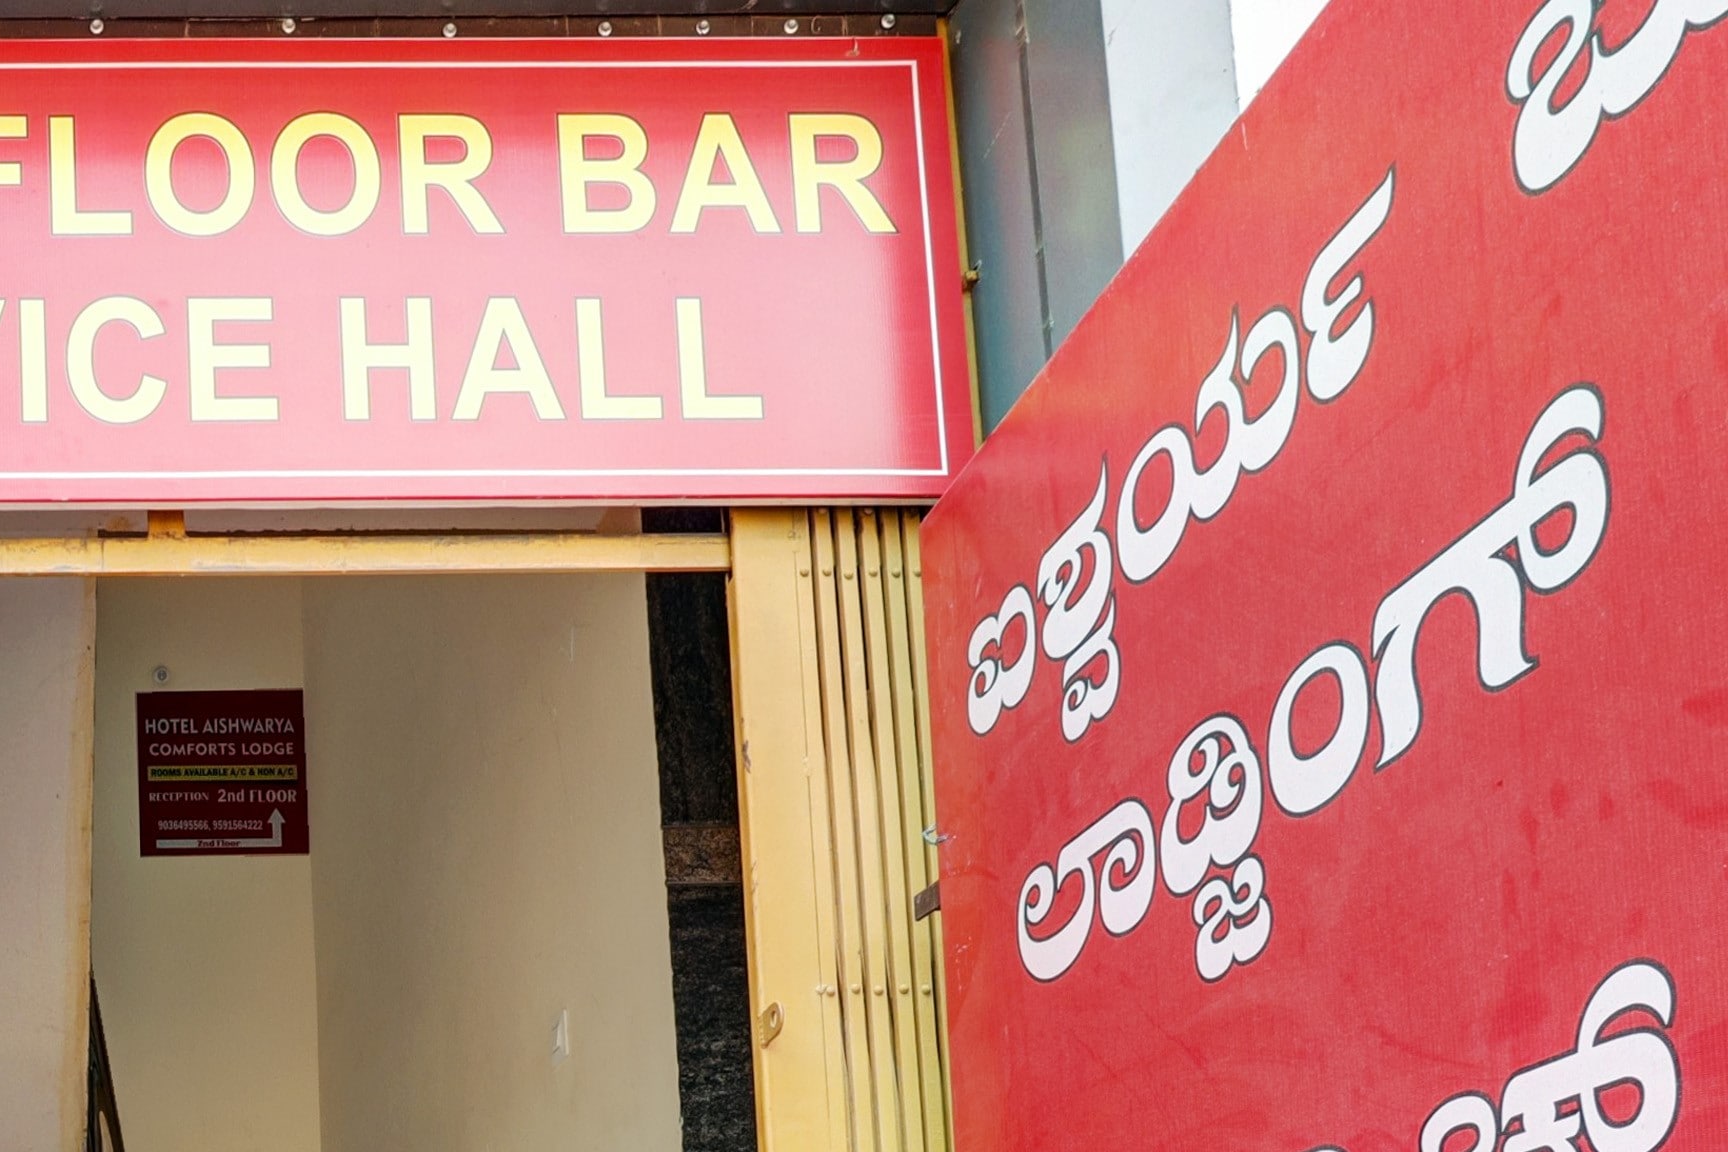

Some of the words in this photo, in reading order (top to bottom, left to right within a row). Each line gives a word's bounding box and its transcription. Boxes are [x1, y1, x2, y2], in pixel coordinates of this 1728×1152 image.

[556, 112, 899, 235] BAR
[338, 296, 765, 422] HALL
[145, 718, 198, 734] HOTEL
[202, 717, 294, 734] AISHWARYA
[149, 743, 236, 756] COMFORTS
[241, 742, 294, 755] LODGE
[151, 768, 181, 777] ROOMS
[183, 768, 227, 777] AVAILABLE
[230, 767, 247, 776] A/C
[249, 767, 255, 776] &
[277, 767, 294, 776] A/C
[149, 792, 209, 802] RECEPTION
[217, 789, 245, 803] 2nd
[250, 789, 297, 803] FLOOR
